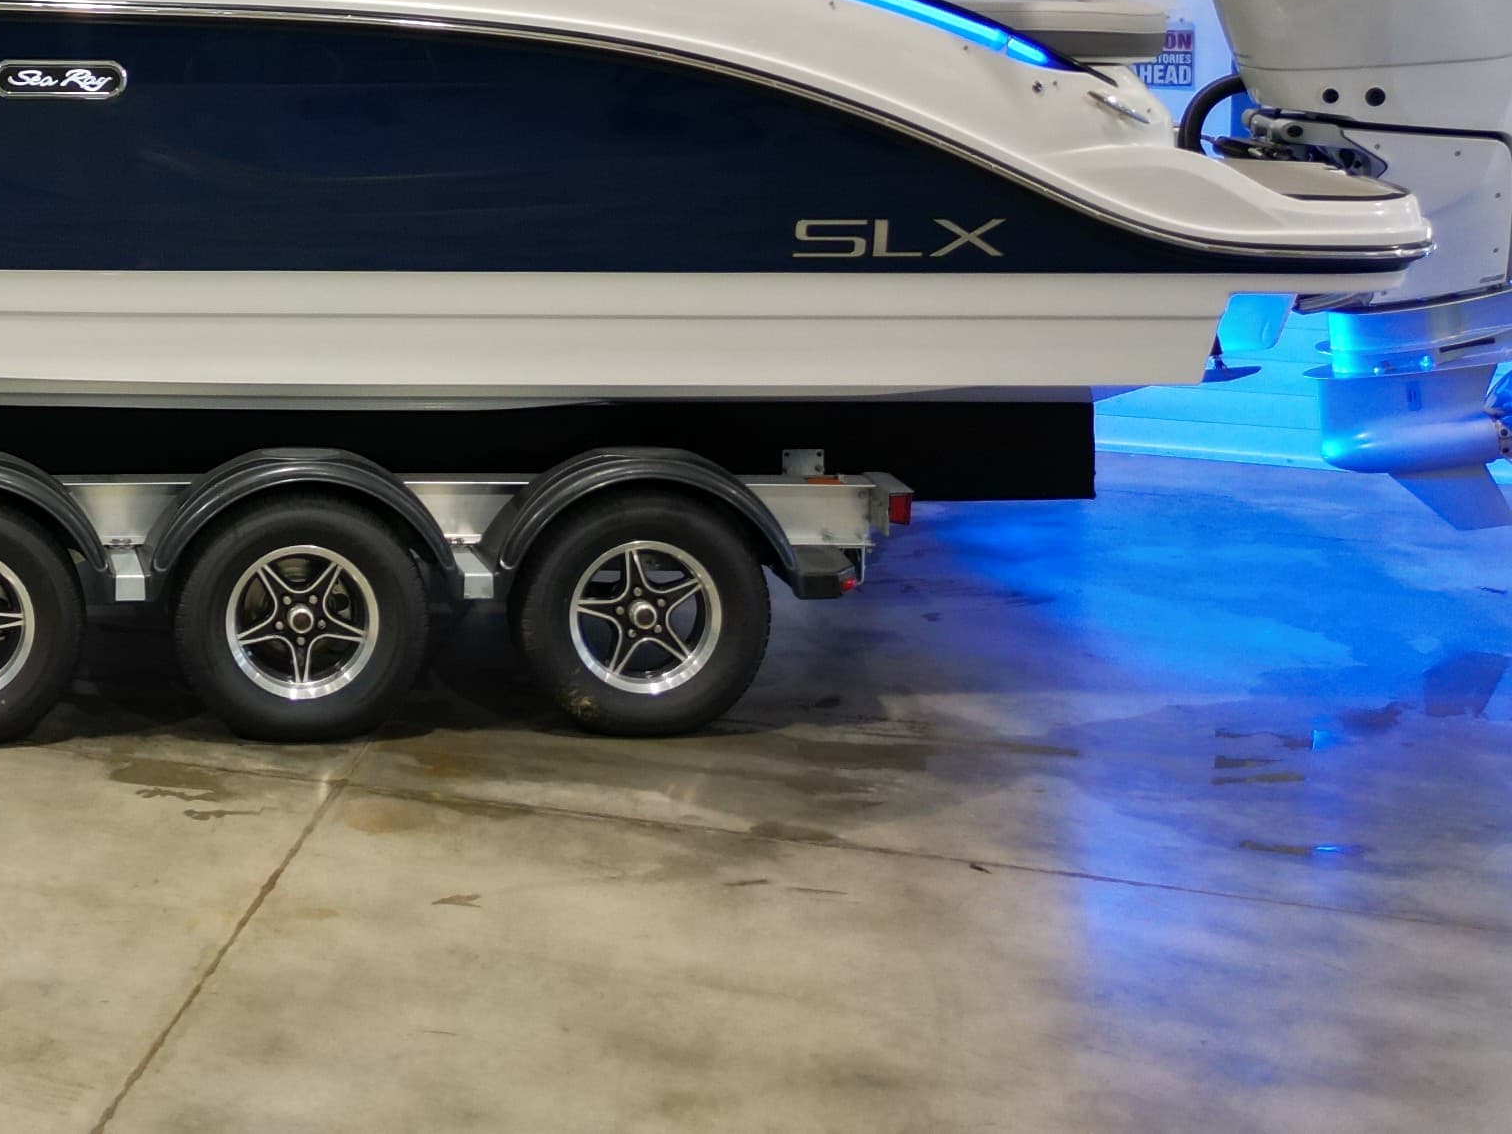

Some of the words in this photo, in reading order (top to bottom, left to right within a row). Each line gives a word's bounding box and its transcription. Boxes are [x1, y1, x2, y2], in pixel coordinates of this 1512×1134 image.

[1152, 54, 1192, 64] TORIES
[7, 69, 58, 87] Sea
[59, 69, 113, 92] Ray
[791, 218, 1007, 258] SLX
